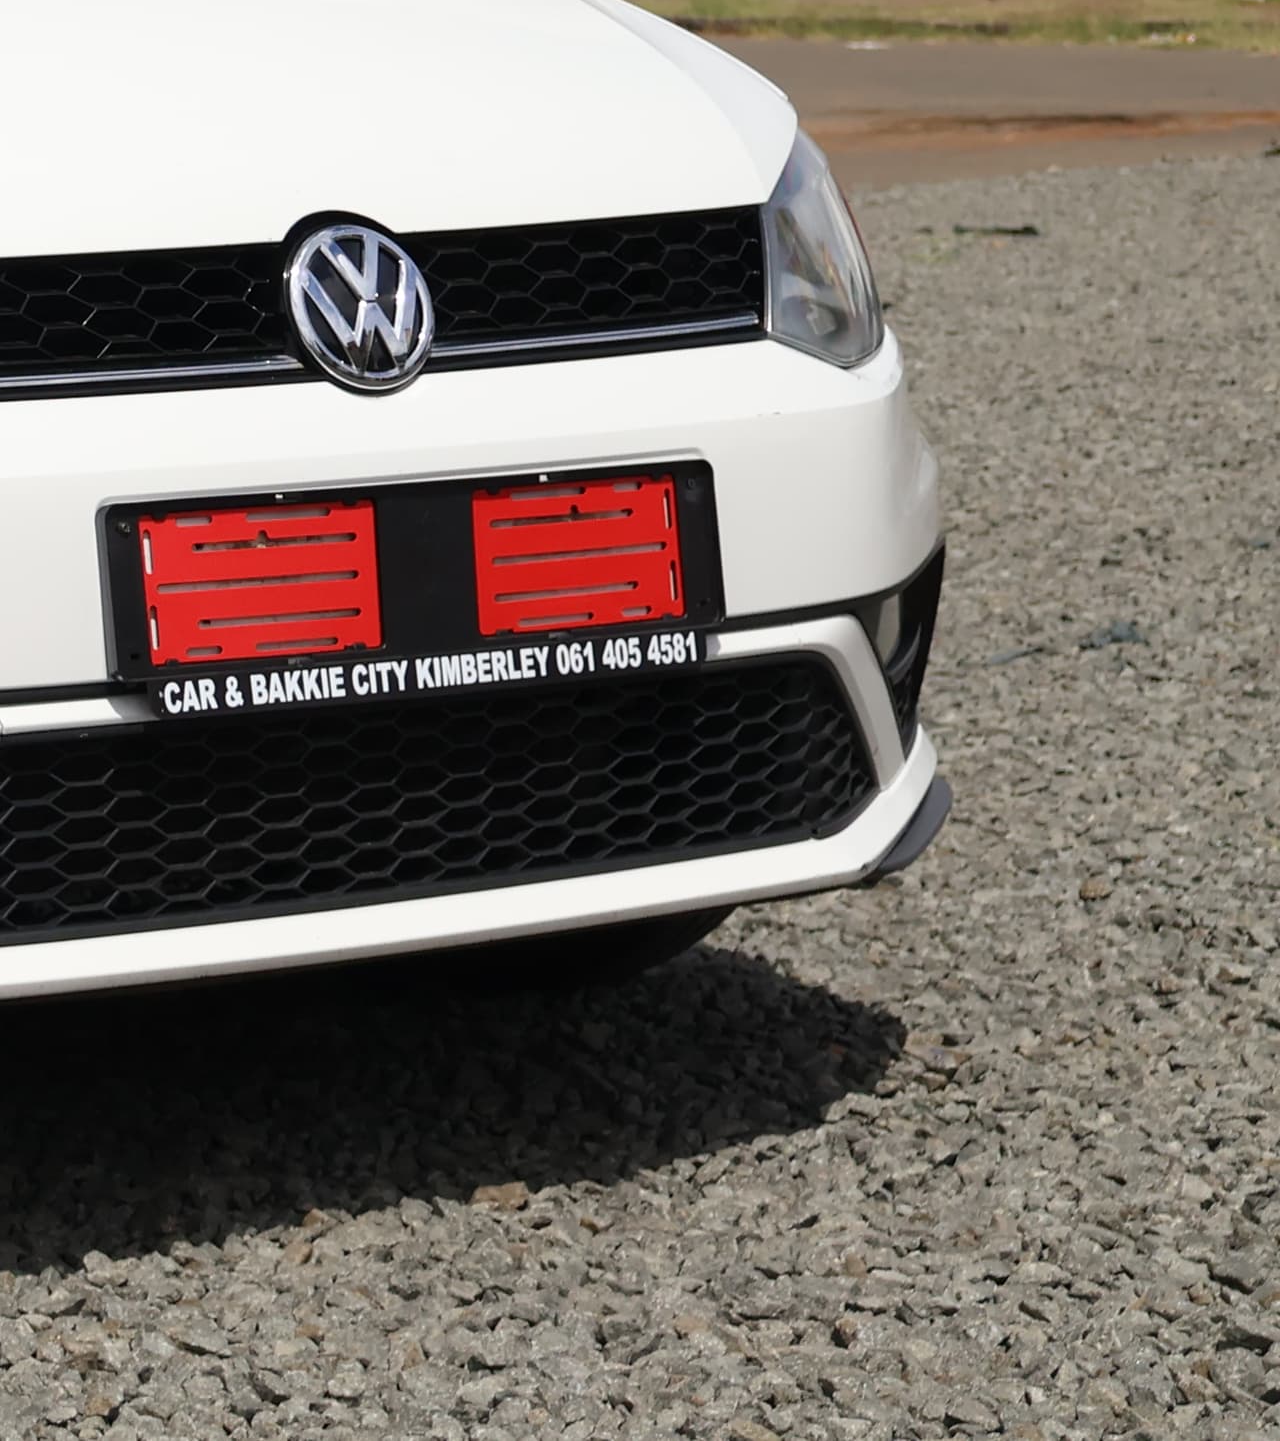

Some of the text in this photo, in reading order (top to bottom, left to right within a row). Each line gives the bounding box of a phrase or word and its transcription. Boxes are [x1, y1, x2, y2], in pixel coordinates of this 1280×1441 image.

[164, 631, 698, 714] CAR & BAKKIE CITY KIMBERLEY 061 405 4581
